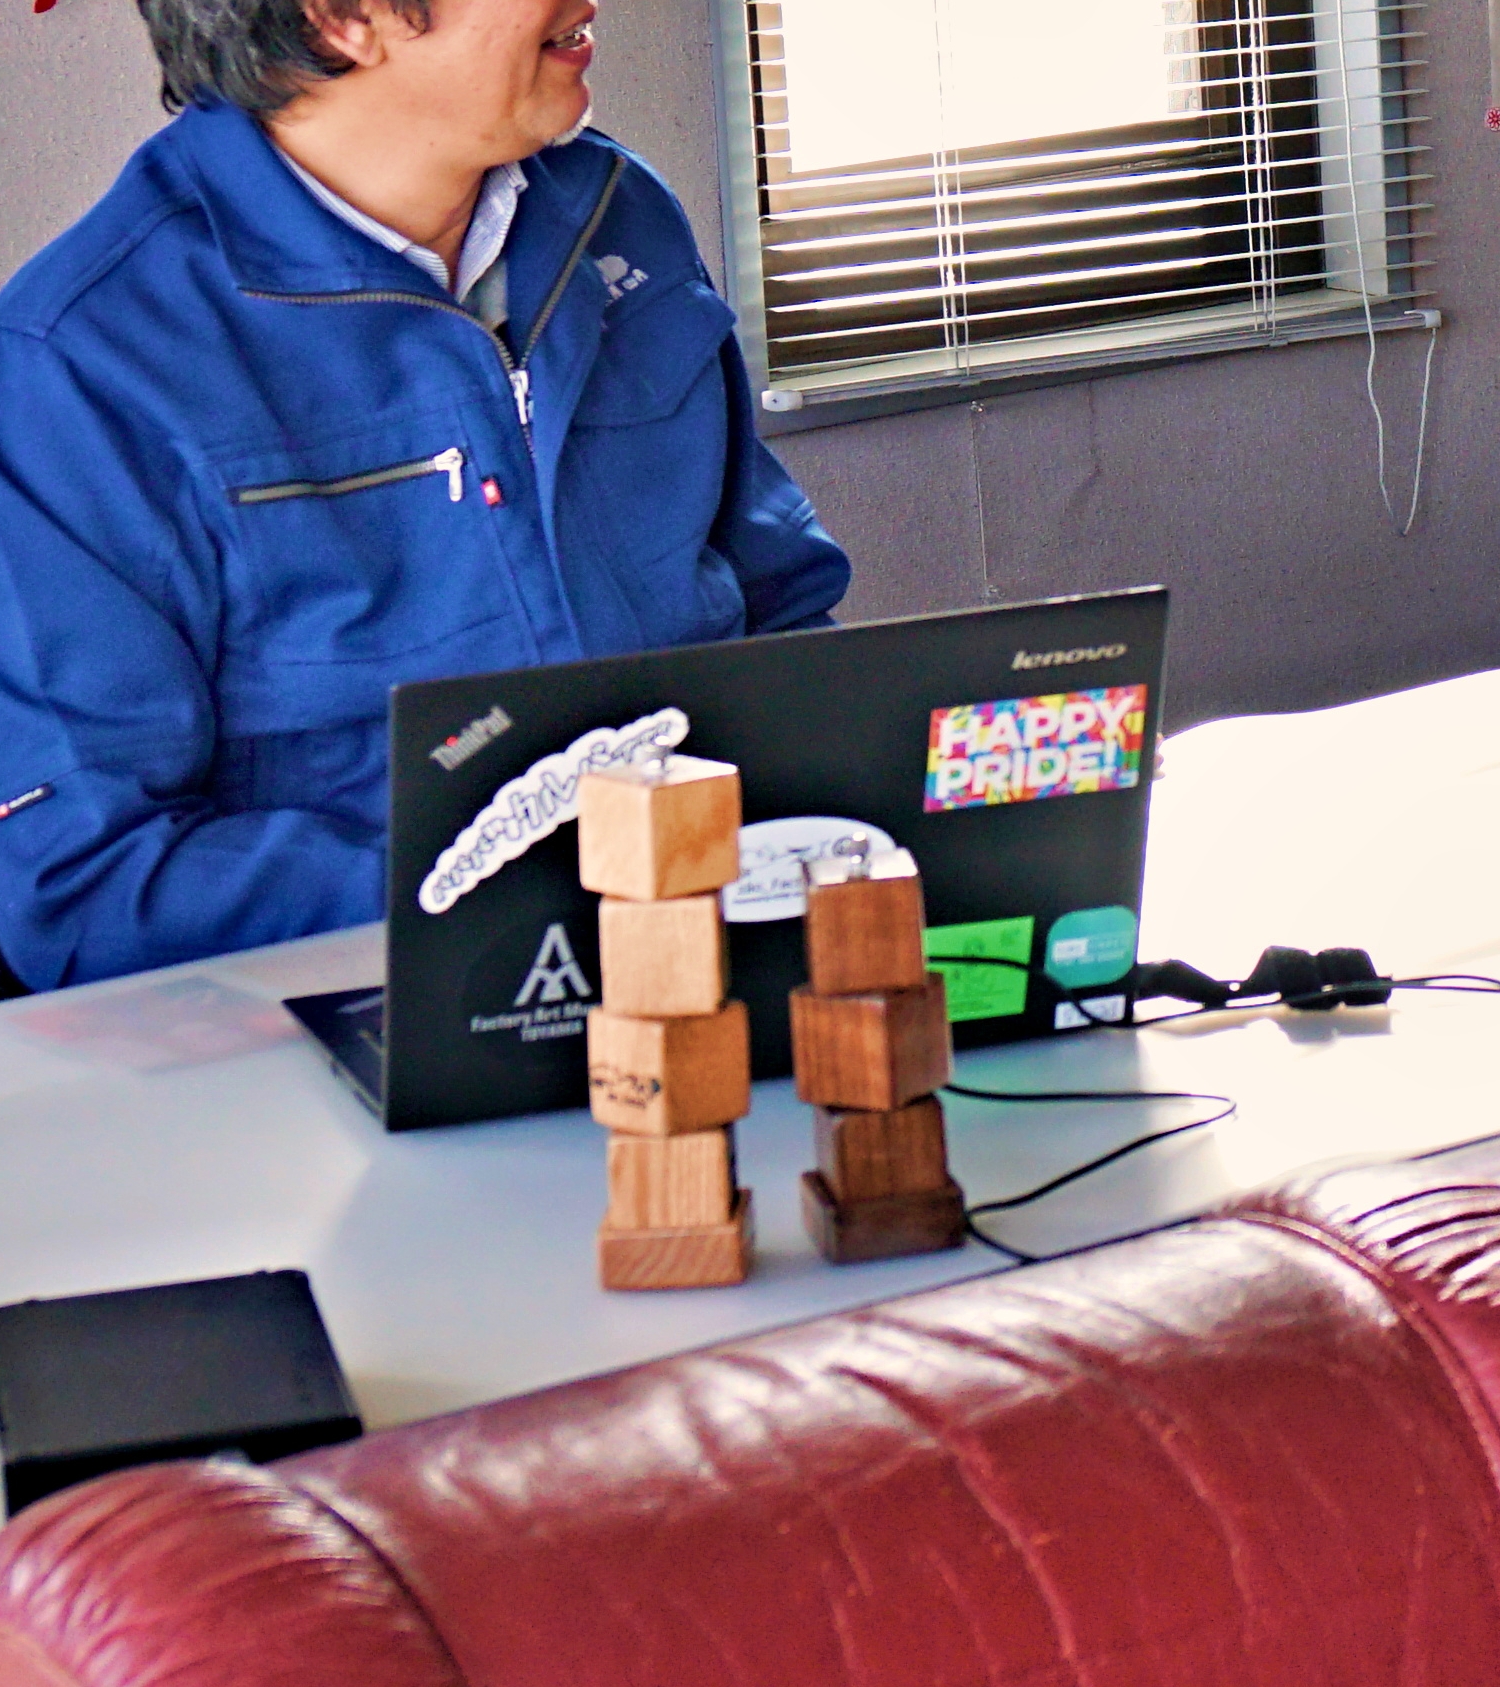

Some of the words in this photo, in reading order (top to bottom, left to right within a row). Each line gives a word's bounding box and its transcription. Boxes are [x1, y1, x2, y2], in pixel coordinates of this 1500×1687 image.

[1011, 643, 1128, 671] lenovo
[429, 707, 513, 771] ThinkPad
[940, 696, 1135, 758] HAPPY
[935, 740, 1119, 800] PRIDE!
[534, 1007, 561, 1022] Art
